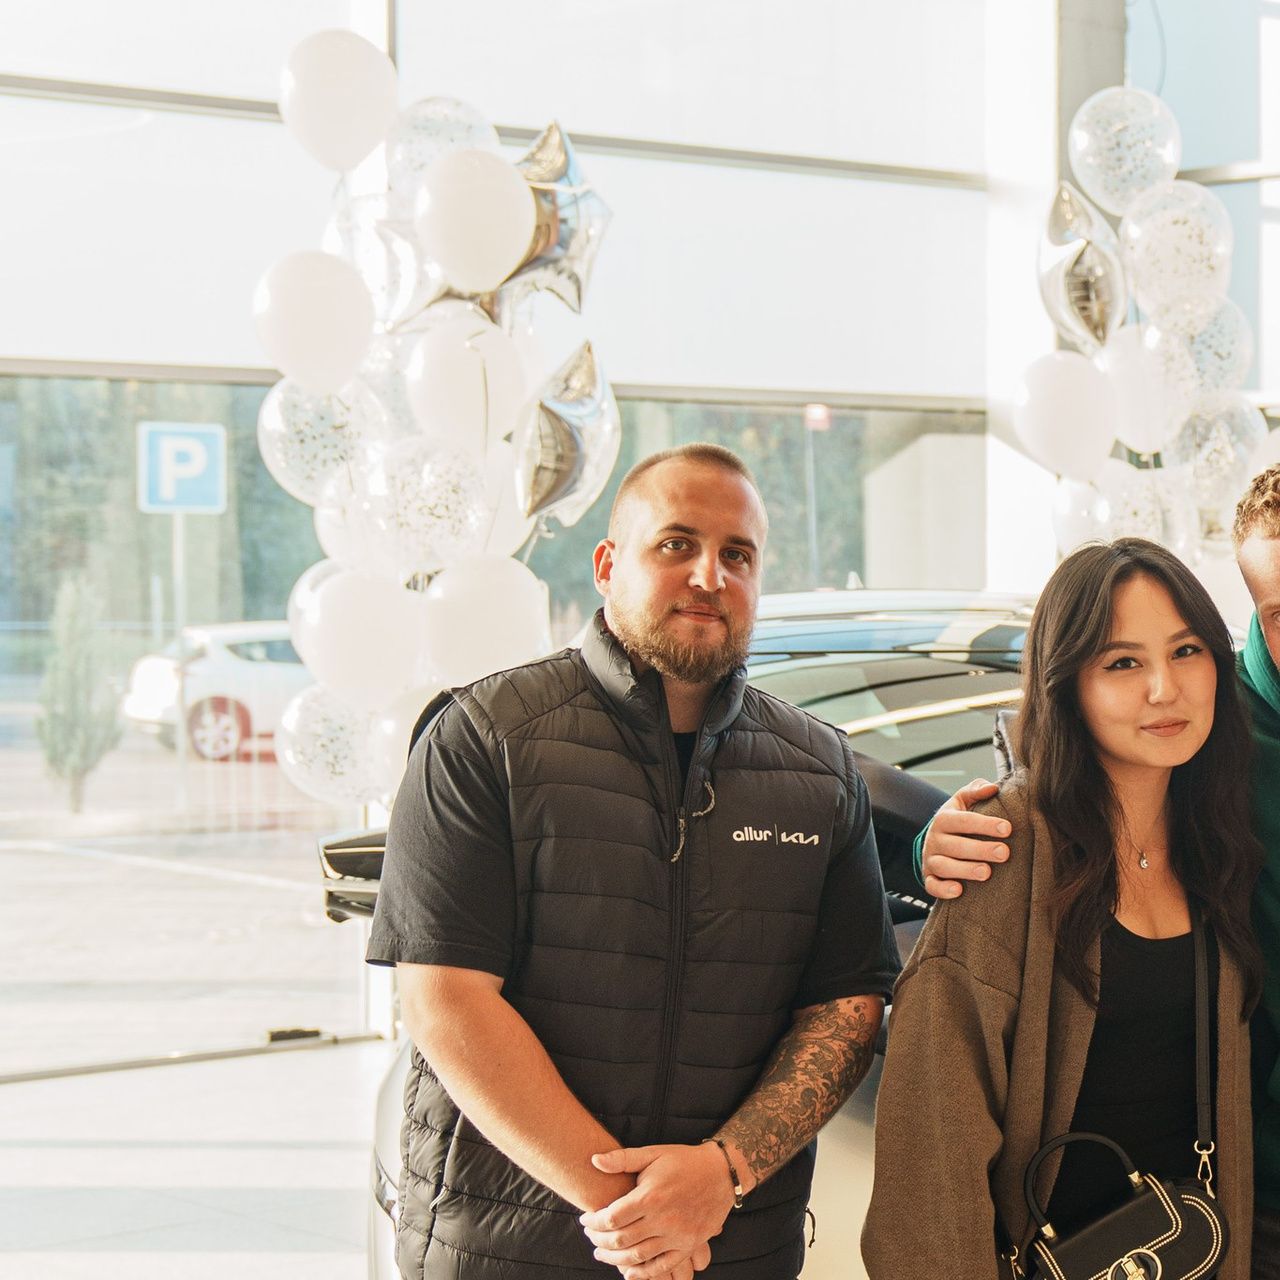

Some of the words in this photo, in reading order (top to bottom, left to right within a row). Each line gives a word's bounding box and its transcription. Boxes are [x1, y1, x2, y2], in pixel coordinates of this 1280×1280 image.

[157, 436, 208, 501] P
[732, 826, 773, 842] allur
[780, 831, 820, 846] KIA
